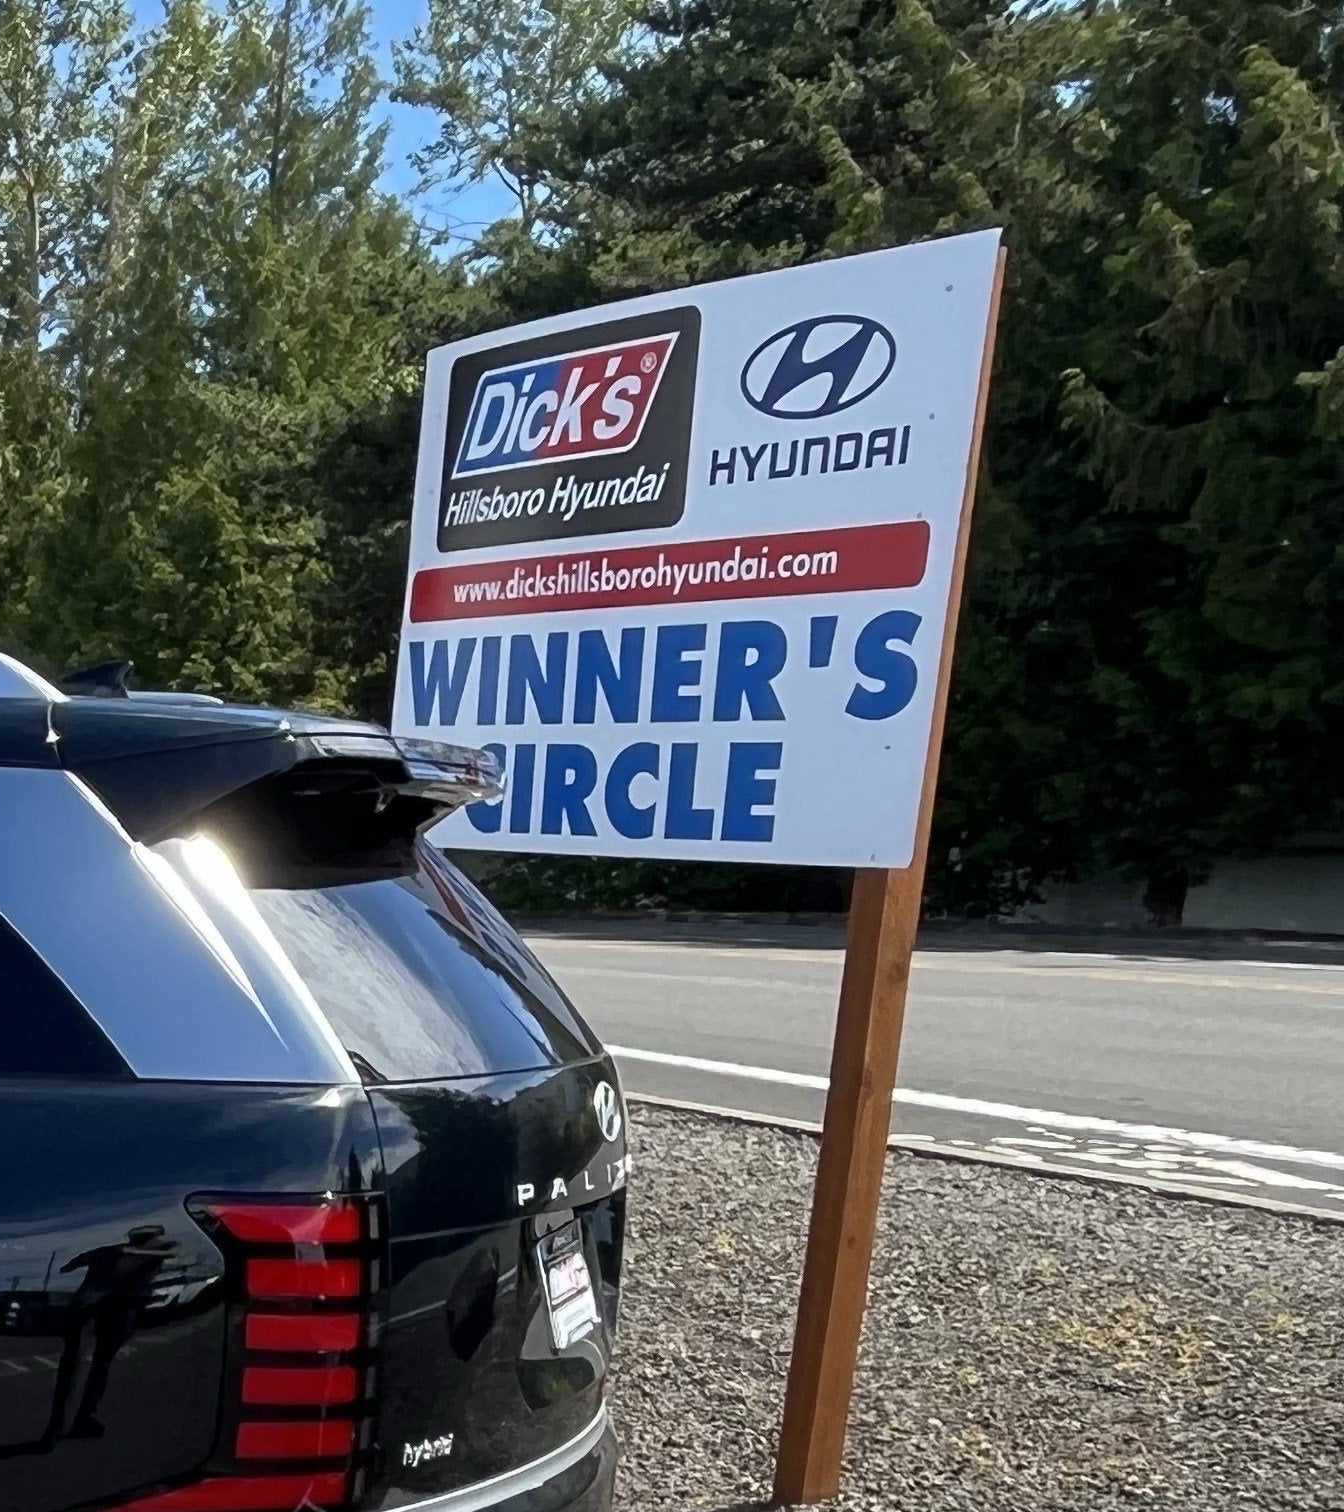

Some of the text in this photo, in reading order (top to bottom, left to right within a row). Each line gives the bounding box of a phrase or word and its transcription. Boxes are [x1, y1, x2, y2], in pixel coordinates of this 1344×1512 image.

[709, 424, 911, 486] HYUNDAI
[444, 463, 671, 528] Hillsboro Hyundai
[453, 545, 838, 603] www.dickshillsborohyundai.com
[409, 610, 923, 727] WINNER'S
